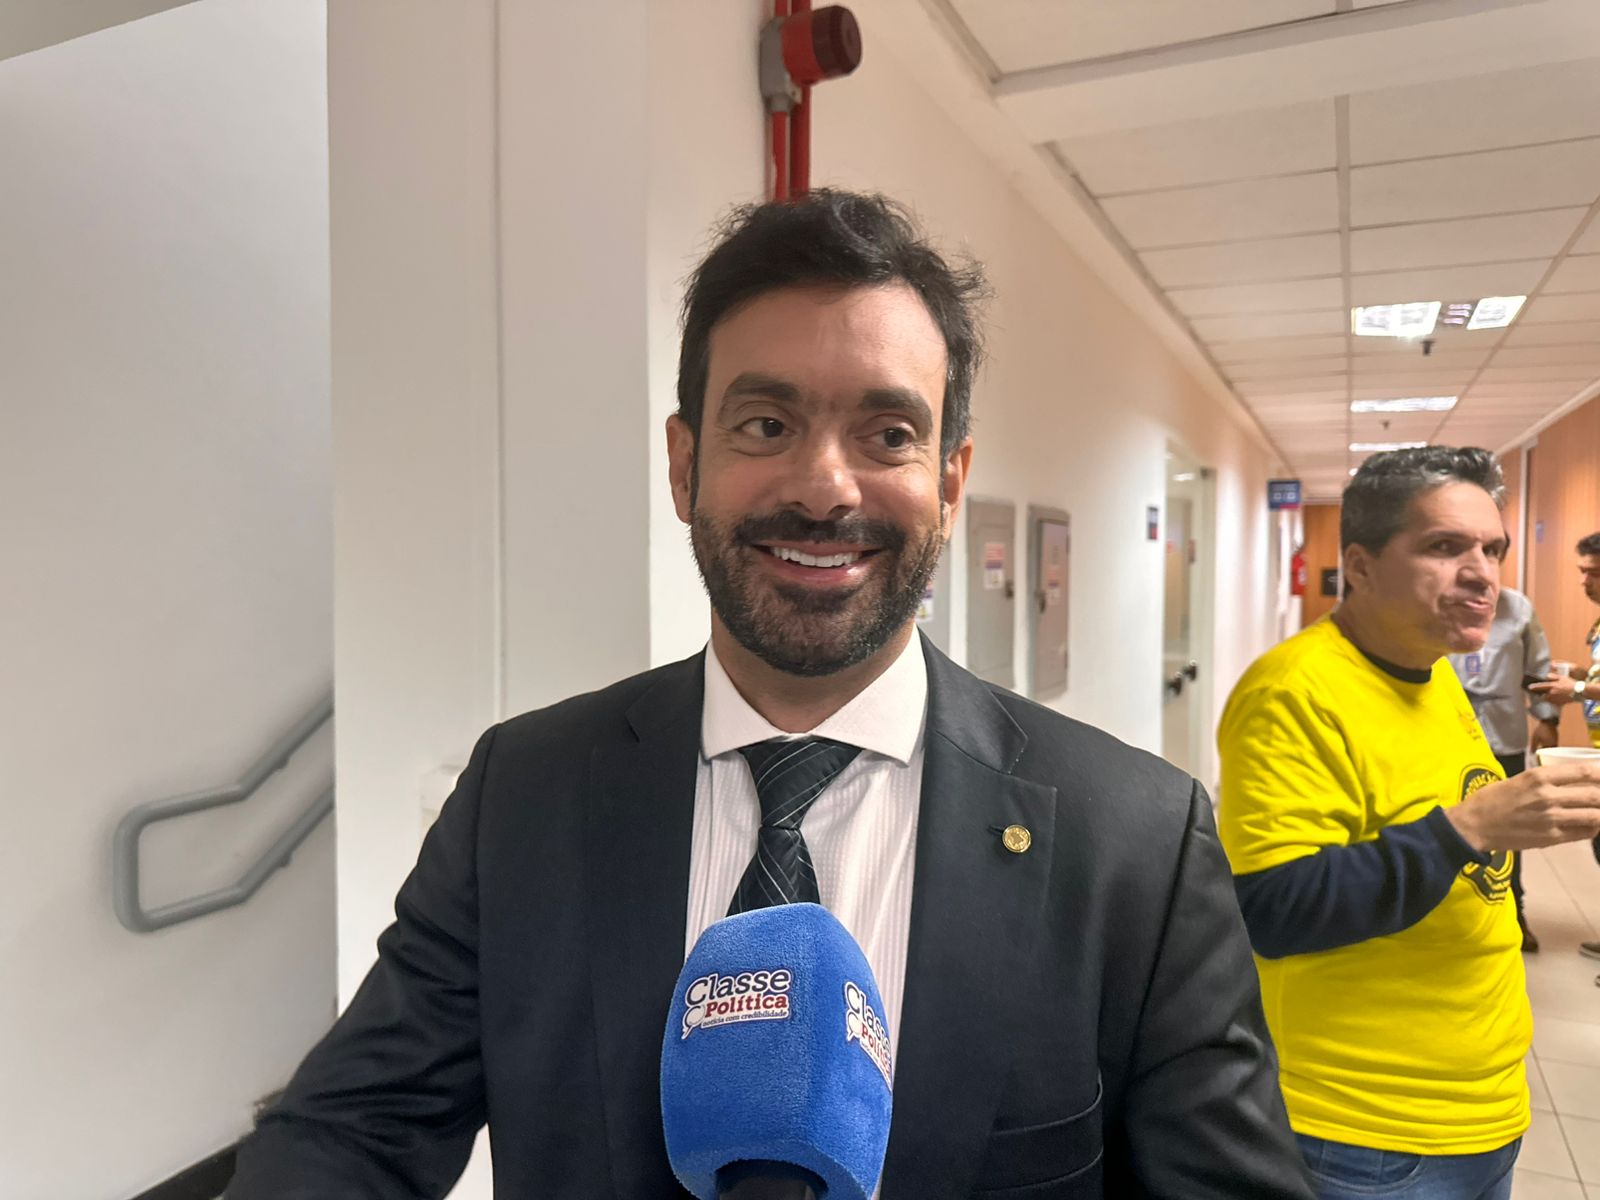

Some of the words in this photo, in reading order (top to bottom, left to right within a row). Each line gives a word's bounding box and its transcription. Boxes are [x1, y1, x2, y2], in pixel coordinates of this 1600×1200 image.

[686, 969, 790, 1006] Classe
[704, 993, 788, 1018] Política
[725, 1014, 740, 1023] com
[741, 1009, 788, 1020] credibilidade
